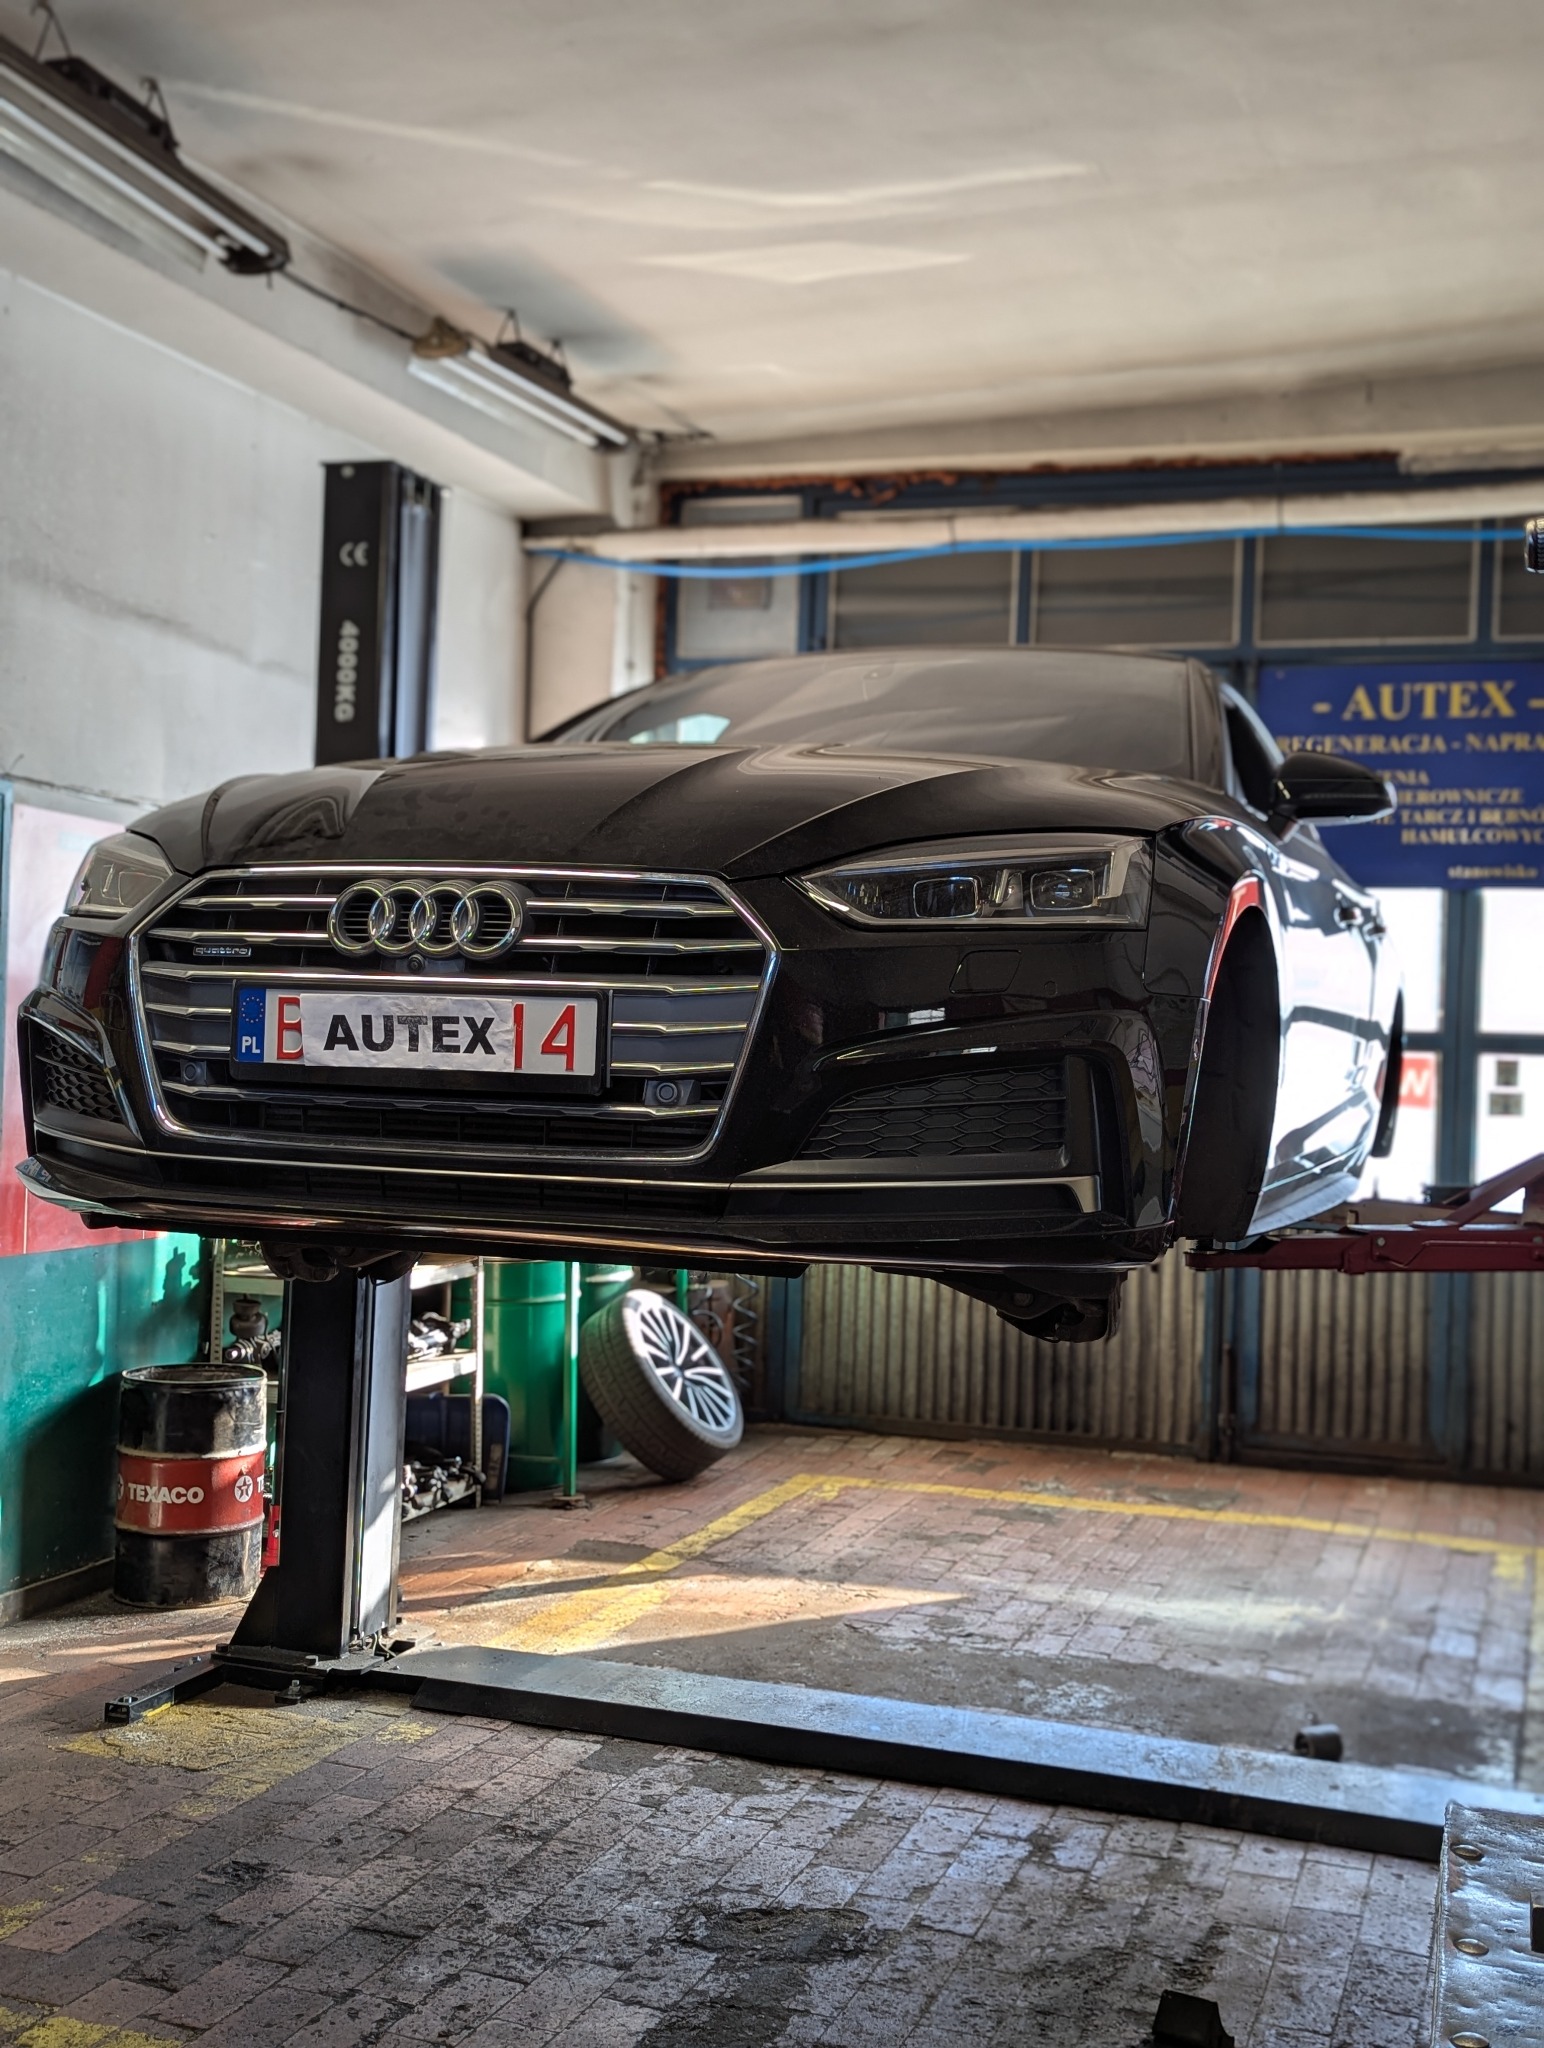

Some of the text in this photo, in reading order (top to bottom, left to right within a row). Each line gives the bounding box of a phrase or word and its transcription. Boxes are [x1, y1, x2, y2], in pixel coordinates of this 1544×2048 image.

[334, 619, 360, 722] 4000KG
[1341, 680, 1516, 721] AUTEX
[1276, 733, 1448, 754] REGENERACJA
[241, 1035, 260, 1053] PL
[323, 1014, 496, 1055] AUTEX
[128, 1482, 205, 1504] TEXACO
